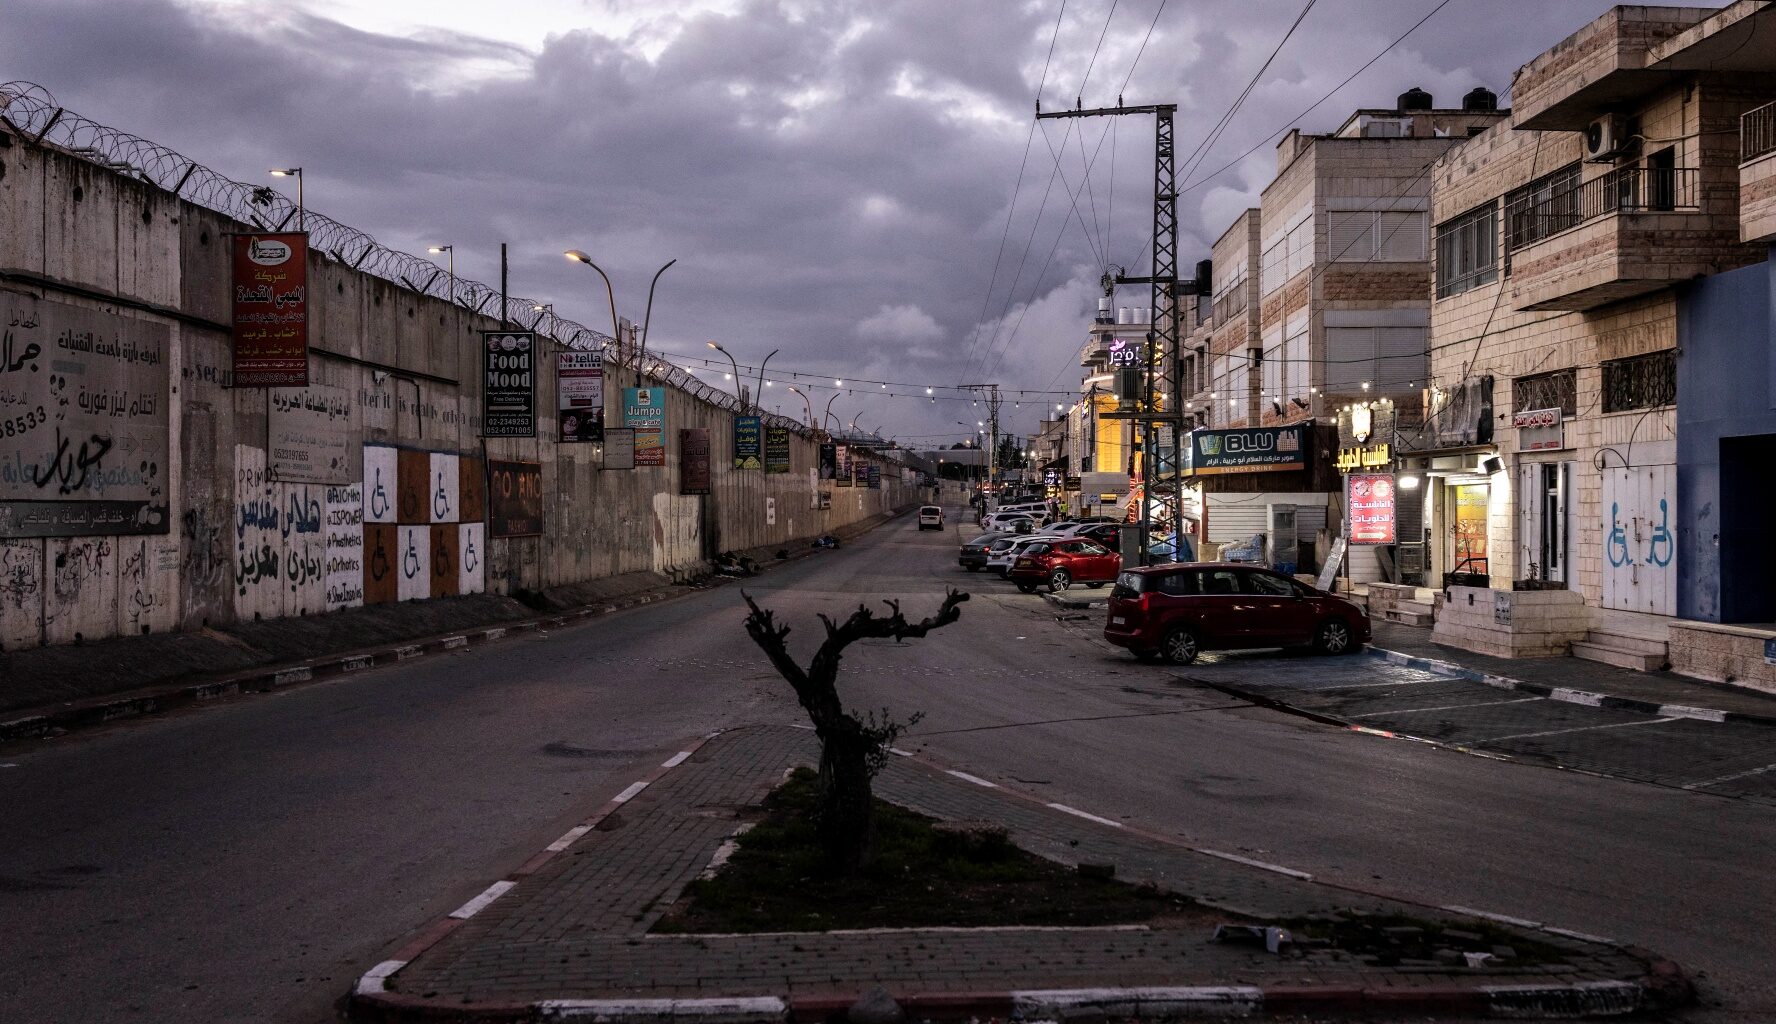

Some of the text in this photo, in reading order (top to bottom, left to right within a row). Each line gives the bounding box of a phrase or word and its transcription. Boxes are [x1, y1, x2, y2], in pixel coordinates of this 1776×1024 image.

[58, 329, 93, 355] التقنيات
[488, 353, 530, 369] Food
[487, 371, 531, 388] Mood
[79, 385, 107, 415] فورية
[628, 406, 661, 418] Jumpo
[1225, 432, 1274, 453] BLU
[1206, 457, 1219, 466] الرام
[1245, 456, 1263, 465] السلام
[1263, 455, 1280, 464] ماركت
[1353, 501, 1391, 511] النابلسية
[1354, 514, 1390, 525] للحلويات
